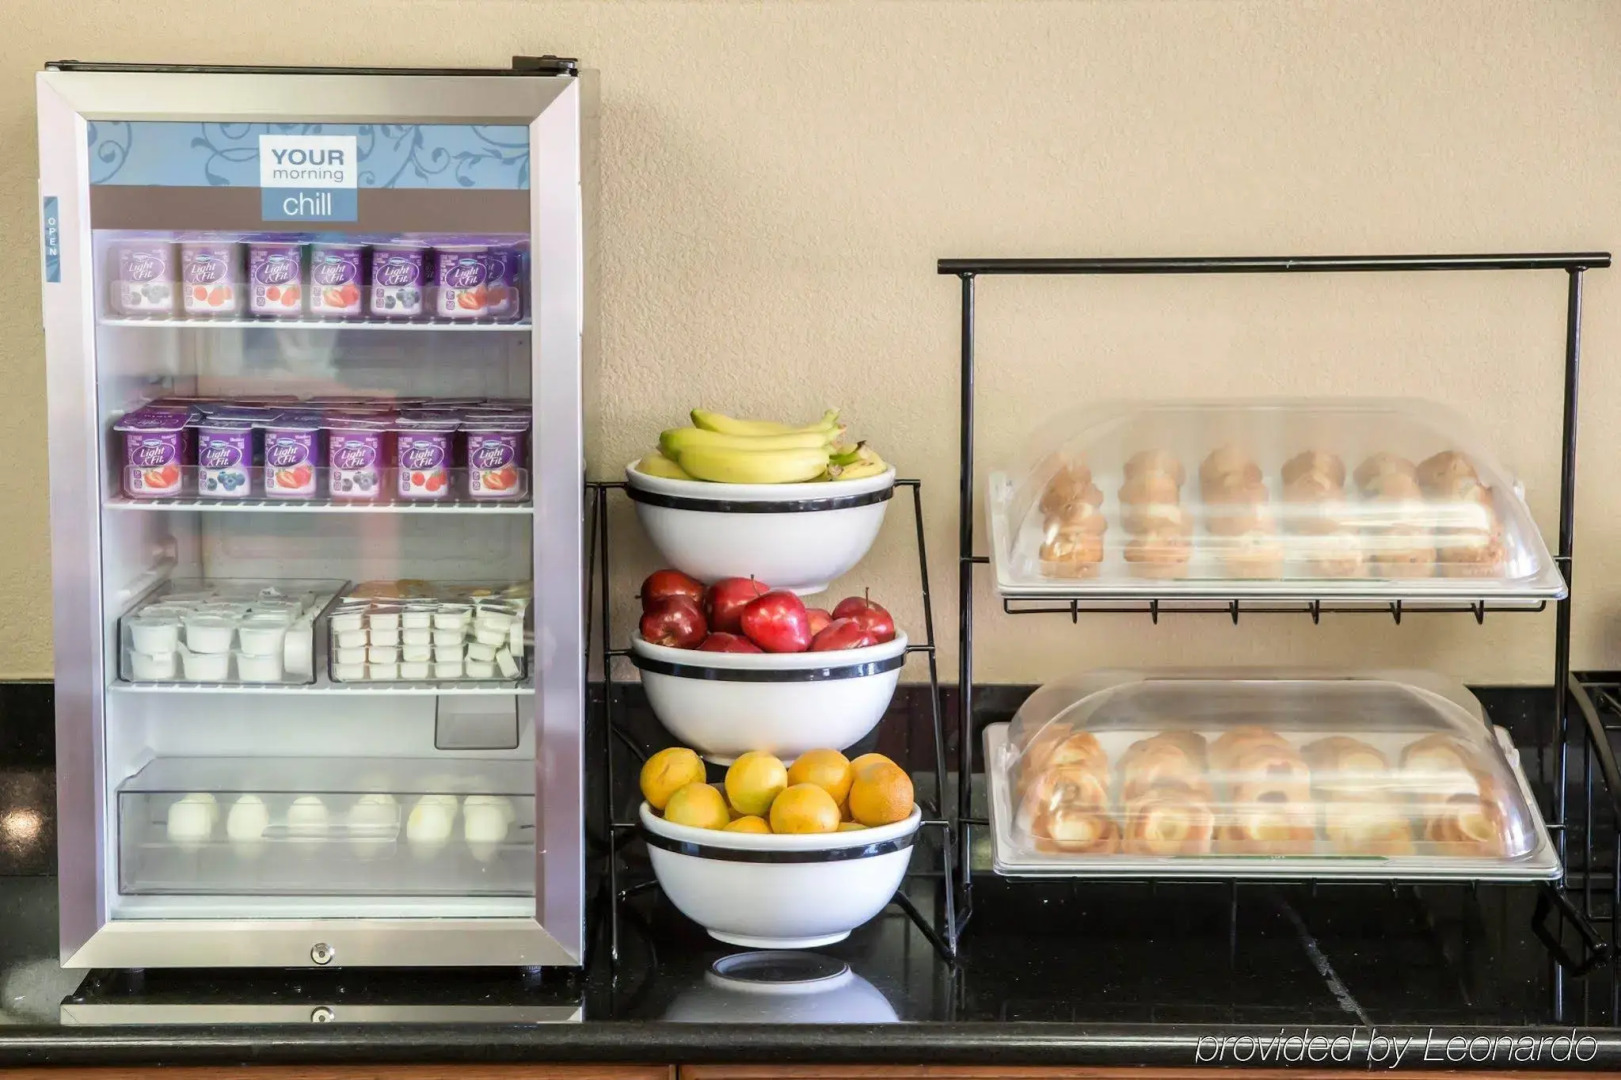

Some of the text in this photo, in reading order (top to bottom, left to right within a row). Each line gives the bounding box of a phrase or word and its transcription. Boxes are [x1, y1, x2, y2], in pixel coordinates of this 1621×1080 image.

[271, 148, 345, 166] YOUR
[273, 167, 344, 183] morning
[283, 192, 332, 216] chill
[48, 217, 57, 256] OPEN
[191, 262, 216, 275] Light
[264, 262, 289, 275] Light
[321, 263, 346, 276] Light
[384, 265, 410, 278] Light
[454, 267, 479, 280] Light
[140, 446, 165, 459] Light
[207, 448, 231, 460] Light
[273, 446, 298, 458] Light
[341, 447, 365, 460] Light
[409, 448, 434, 460] Light
[480, 448, 504, 460] Light
